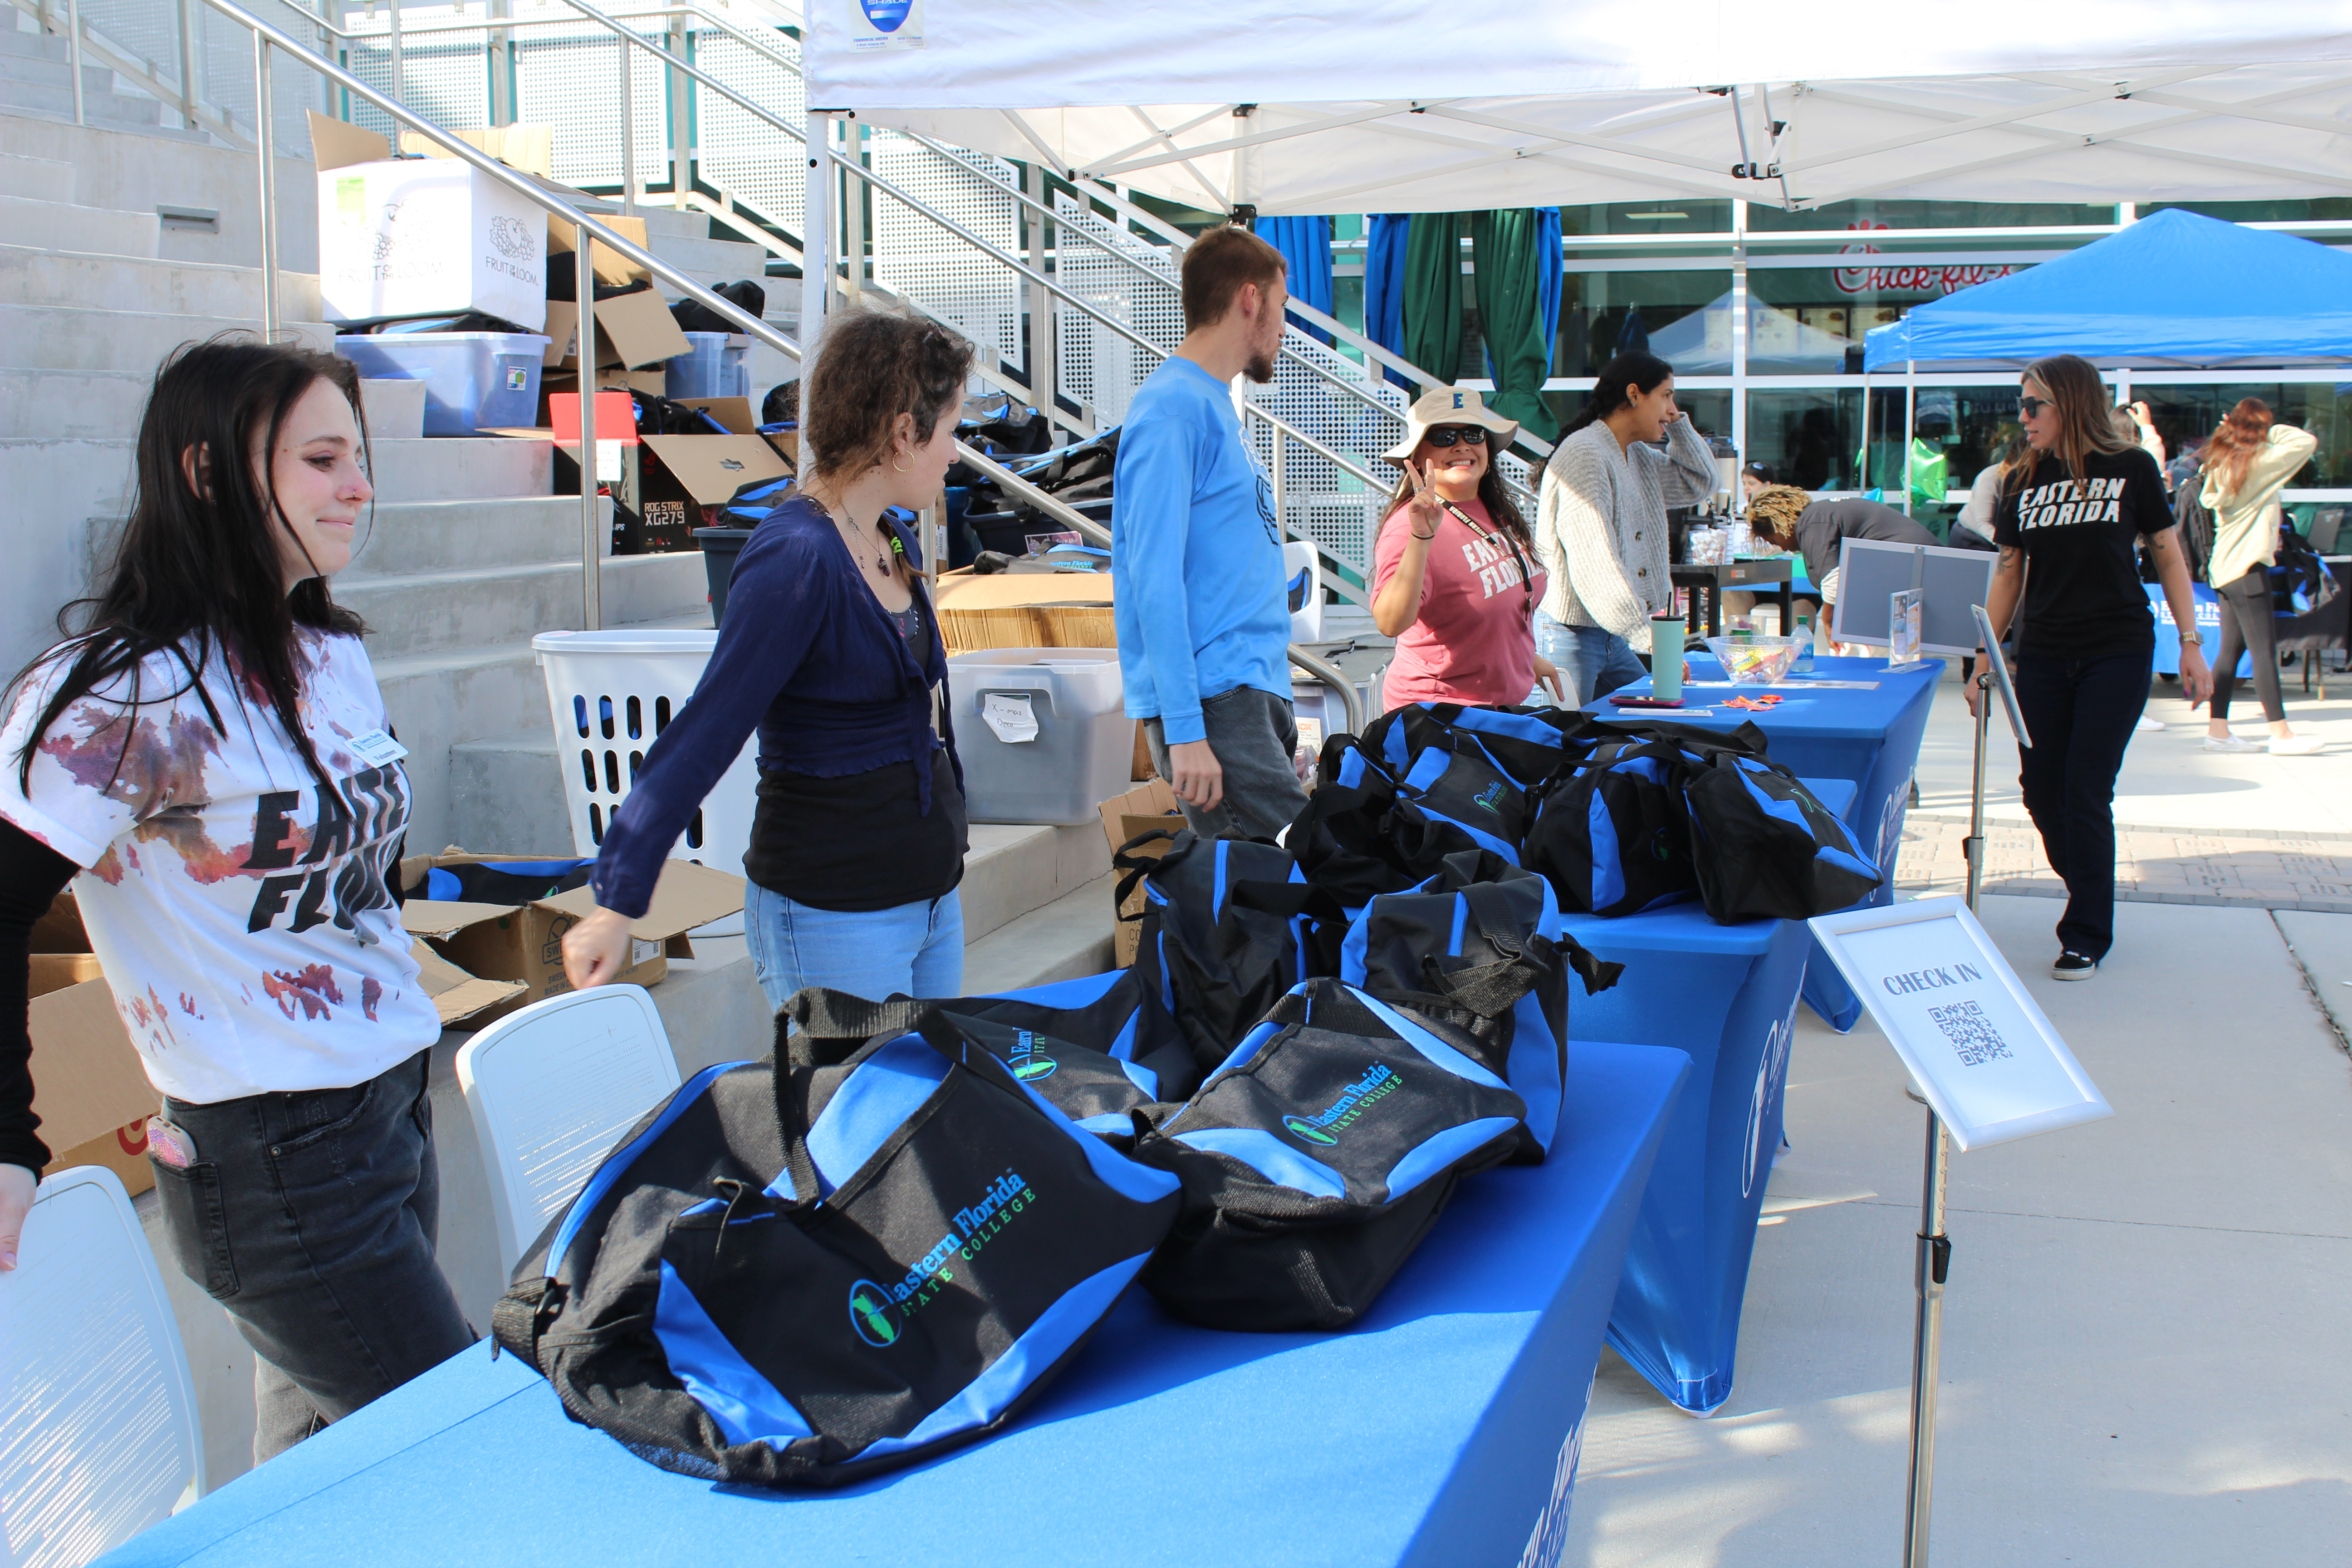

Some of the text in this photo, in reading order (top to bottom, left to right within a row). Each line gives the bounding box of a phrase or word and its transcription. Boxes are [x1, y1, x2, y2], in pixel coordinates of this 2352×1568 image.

[339, 265, 381, 283] FRUIT
[397, 262, 443, 278] LOOM
[486, 256, 509, 274] FRUIT
[381, 272, 394, 280] THE
[1452, 392, 1464, 409] E
[2018, 478, 2127, 512] EASTERN
[644, 501, 684, 512] ROG STRIX
[2018, 500, 2120, 532] FLORIDA
[645, 511, 685, 526] XG279
[997, 718, 1014, 728] Deco
[545, 984, 559, 995] MADE
[560, 981, 566, 990] IN
[1883, 962, 1983, 995] CHECK IN
[1343, 1063, 1392, 1098] Florida
[1359, 1074, 1402, 1107] COLLEGE
[953, 1173, 1026, 1239] Florida
[961, 1188, 1036, 1260] COLLEGE
